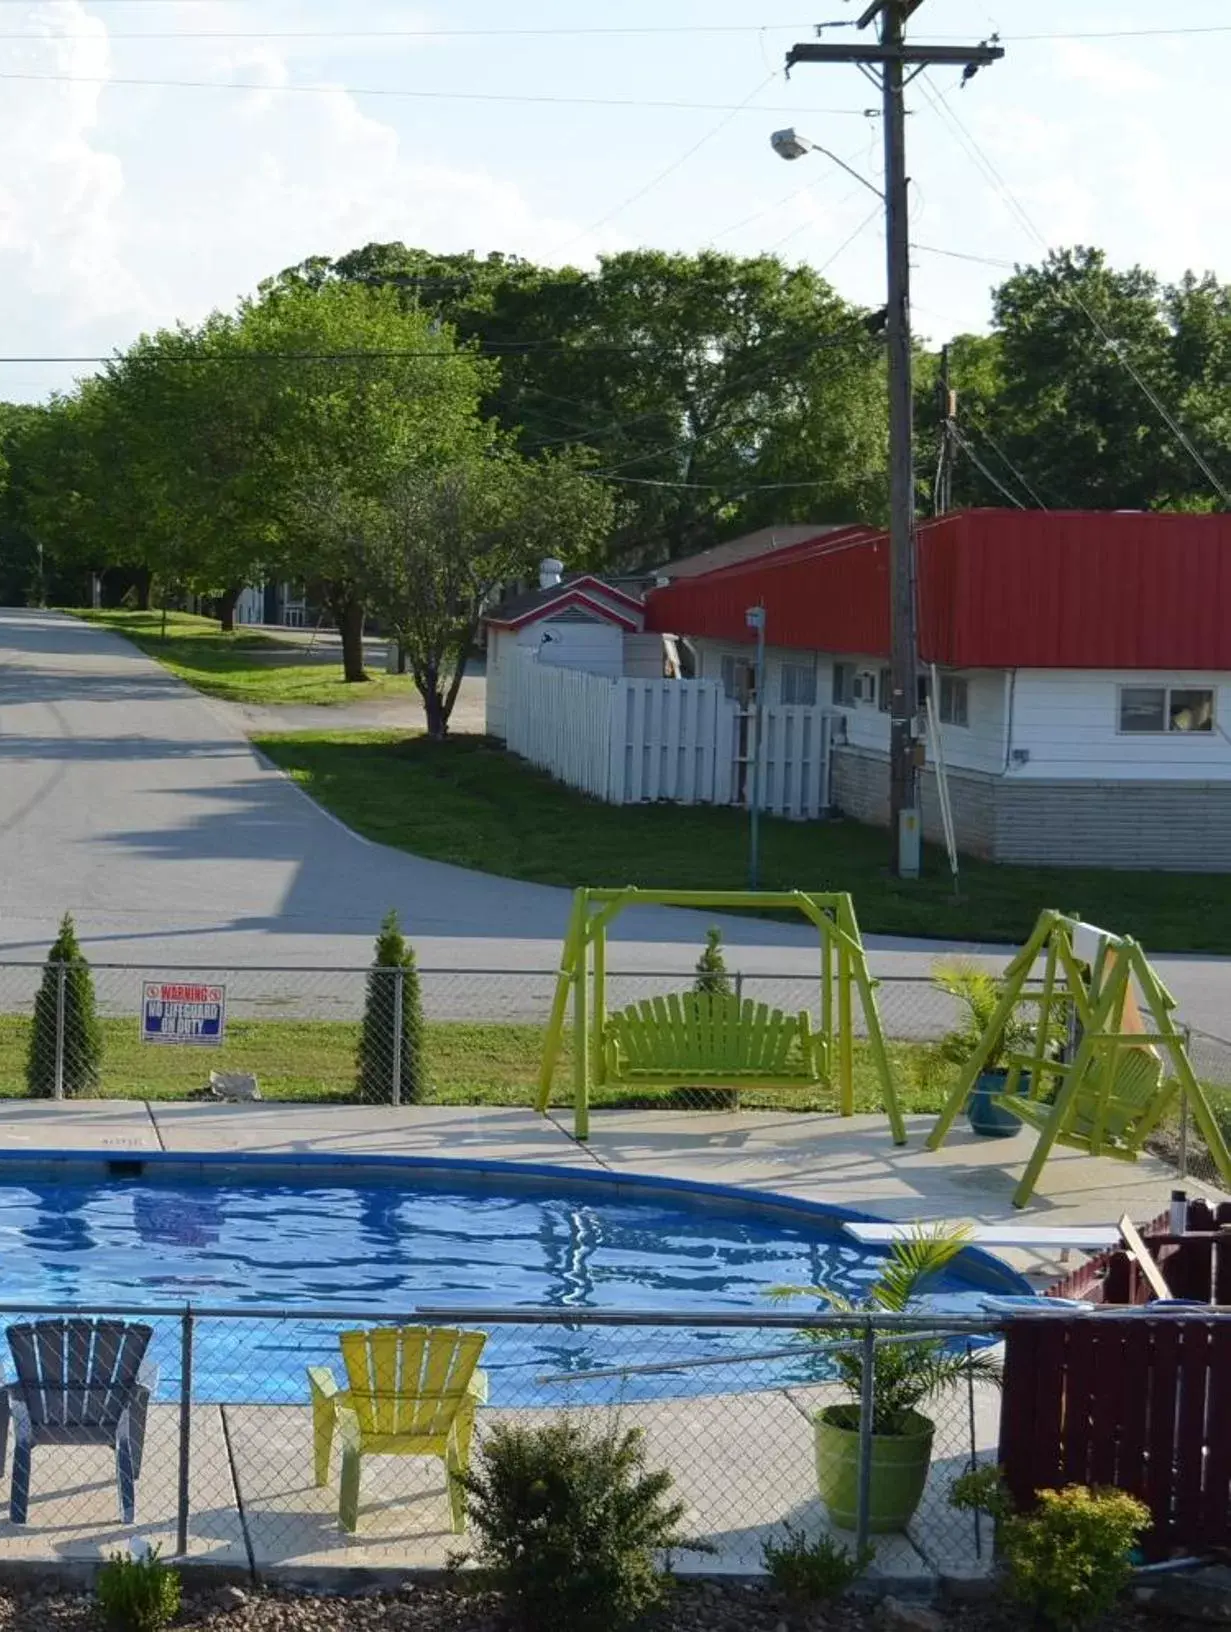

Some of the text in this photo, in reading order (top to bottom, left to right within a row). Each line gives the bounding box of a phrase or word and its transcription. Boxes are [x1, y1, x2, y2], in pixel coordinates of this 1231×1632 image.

[161, 986, 208, 1002] WARNING
[148, 1001, 218, 1020] NO LIFEGUARD
[161, 1017, 204, 1035] ON DUTY
